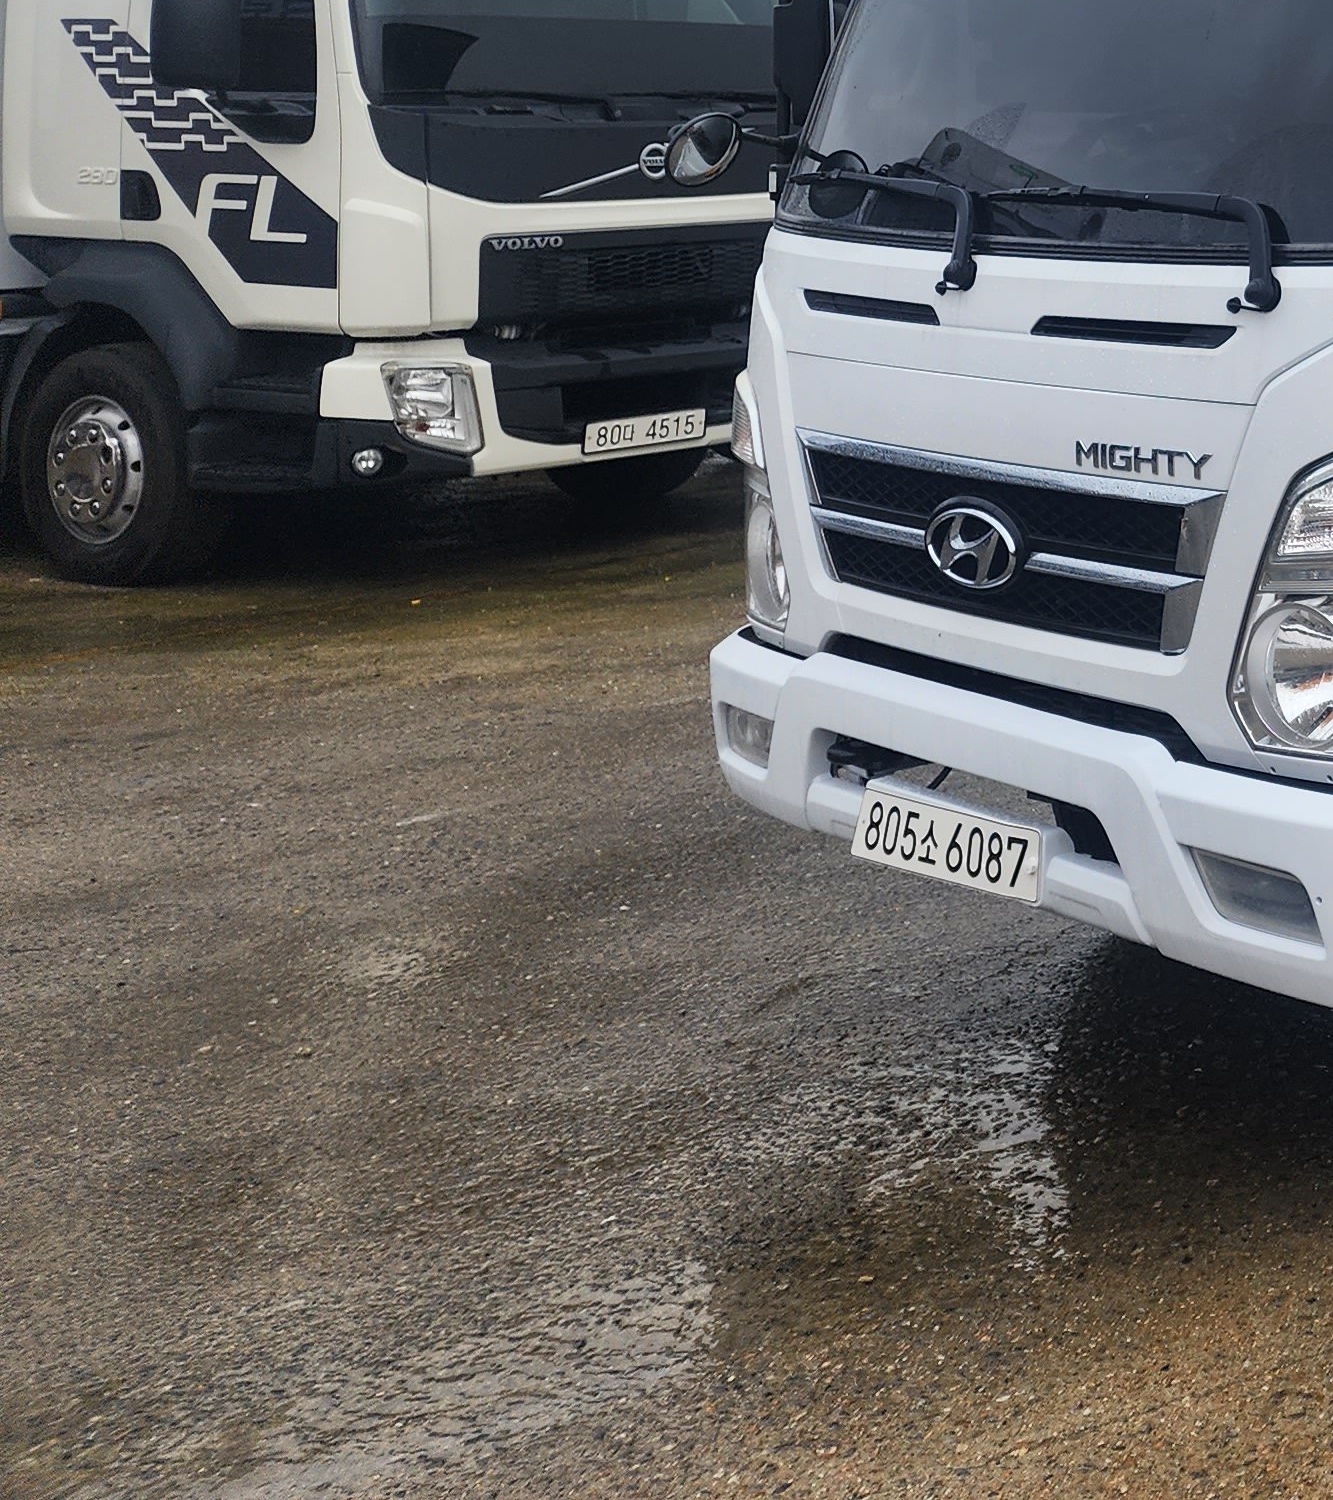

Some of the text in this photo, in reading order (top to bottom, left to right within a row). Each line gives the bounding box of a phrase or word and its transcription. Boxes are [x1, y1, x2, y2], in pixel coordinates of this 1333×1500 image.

[195, 173, 308, 244] FL
[488, 236, 564, 251] VOLVO
[596, 414, 695, 447] 80다 4515
[1075, 439, 1214, 481] MIGHTY
[865, 801, 1029, 888] 805소 6087
